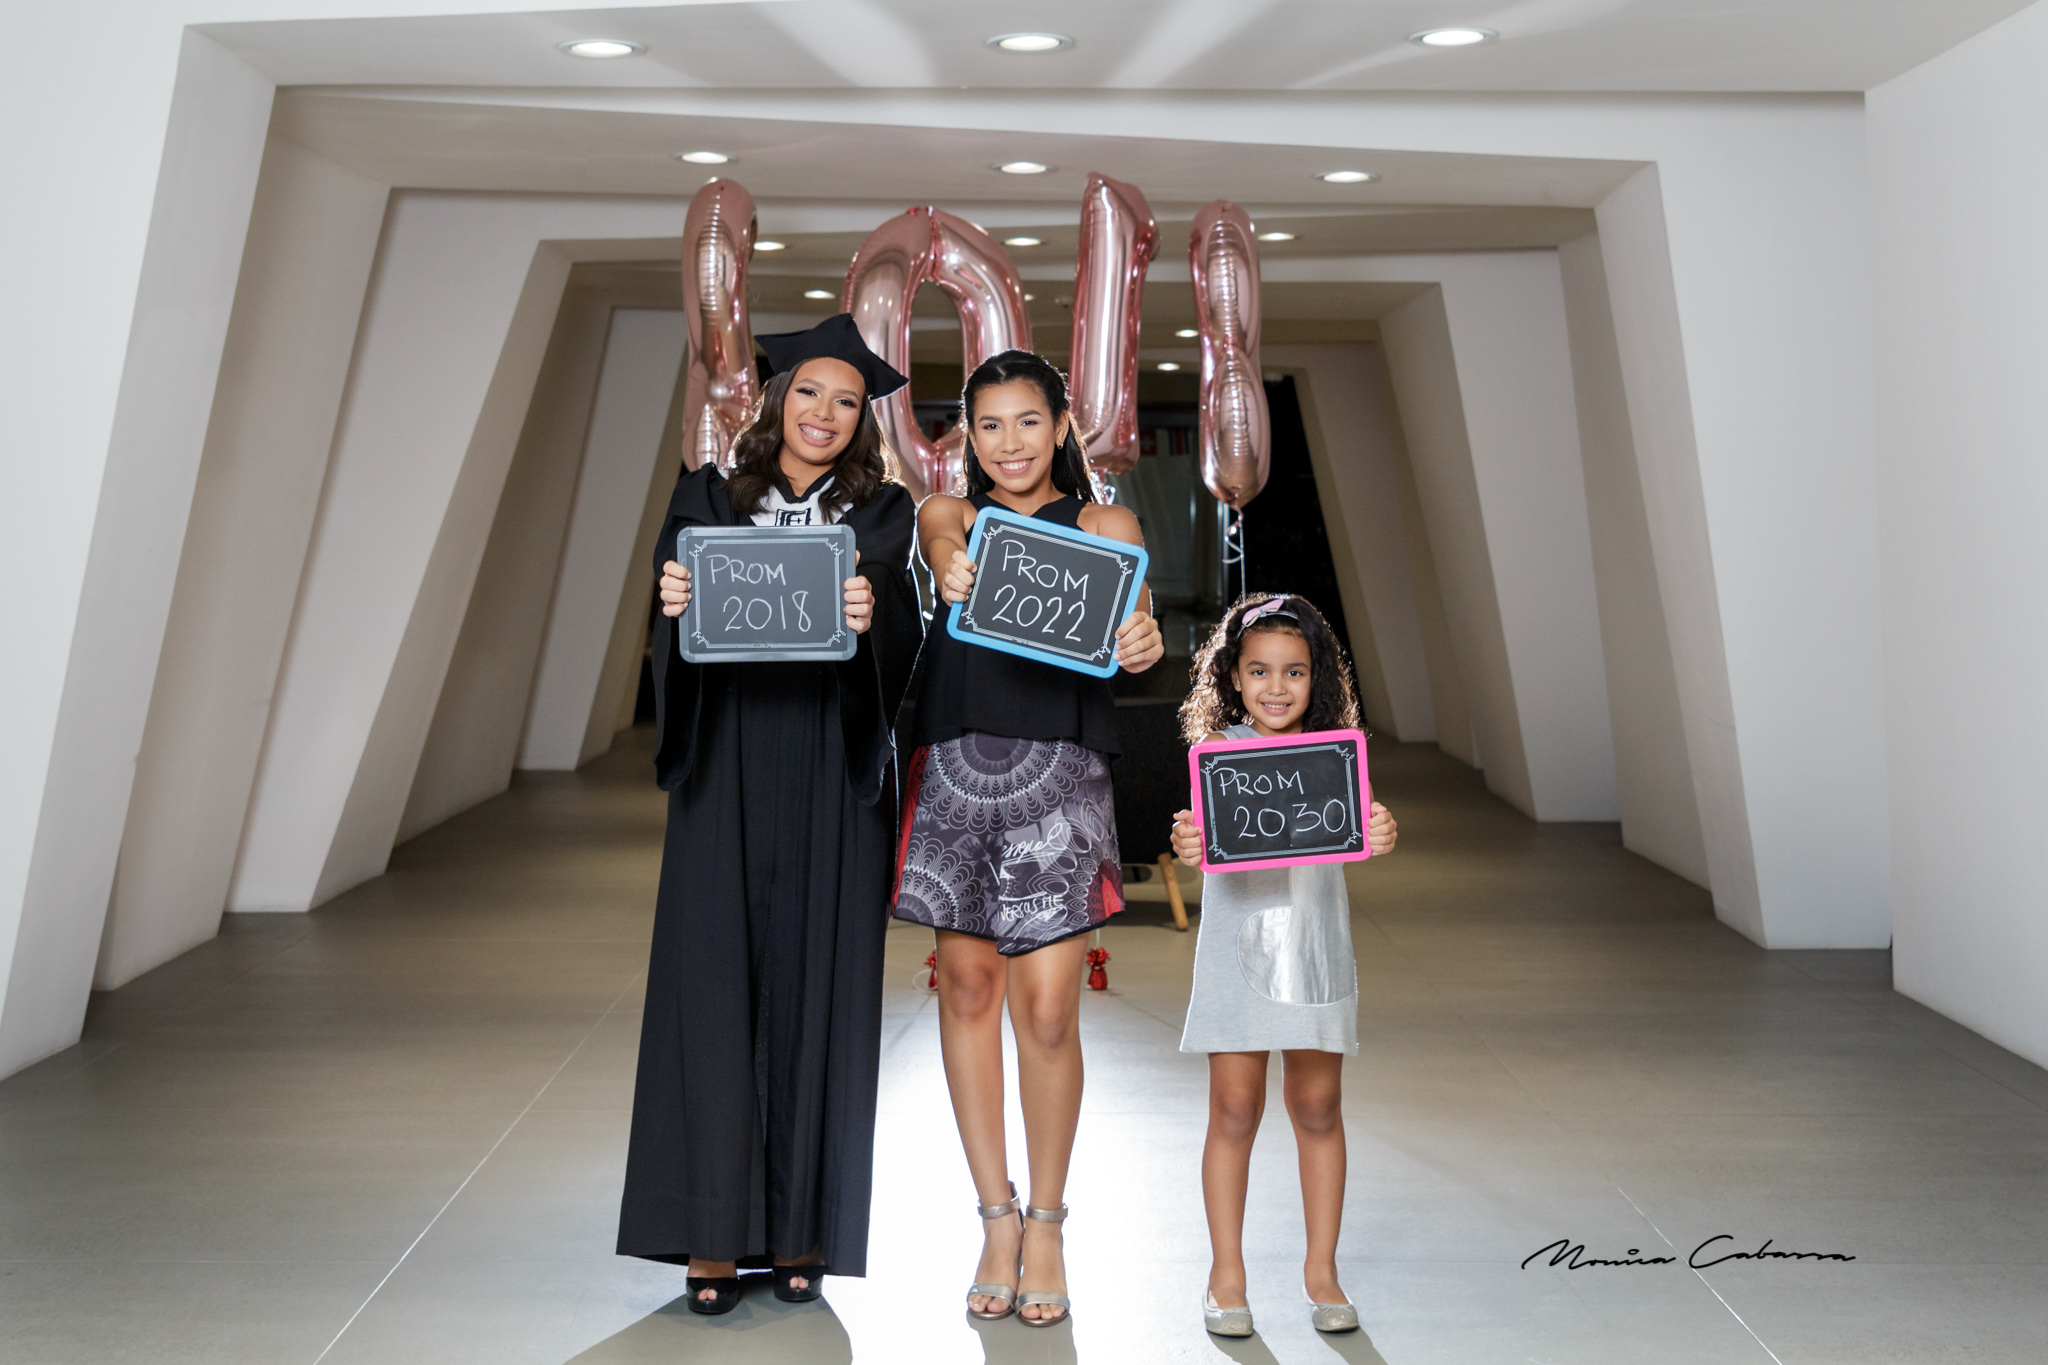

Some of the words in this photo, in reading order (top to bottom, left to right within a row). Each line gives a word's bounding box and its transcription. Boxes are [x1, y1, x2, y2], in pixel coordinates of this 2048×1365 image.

[705, 554, 787, 586] PROM
[1001, 539, 1090, 601] PROM
[722, 590, 812, 633] 2018
[991, 584, 1086, 642] 2022
[1212, 767, 1305, 797] PROM
[1233, 798, 1346, 839] 2030
